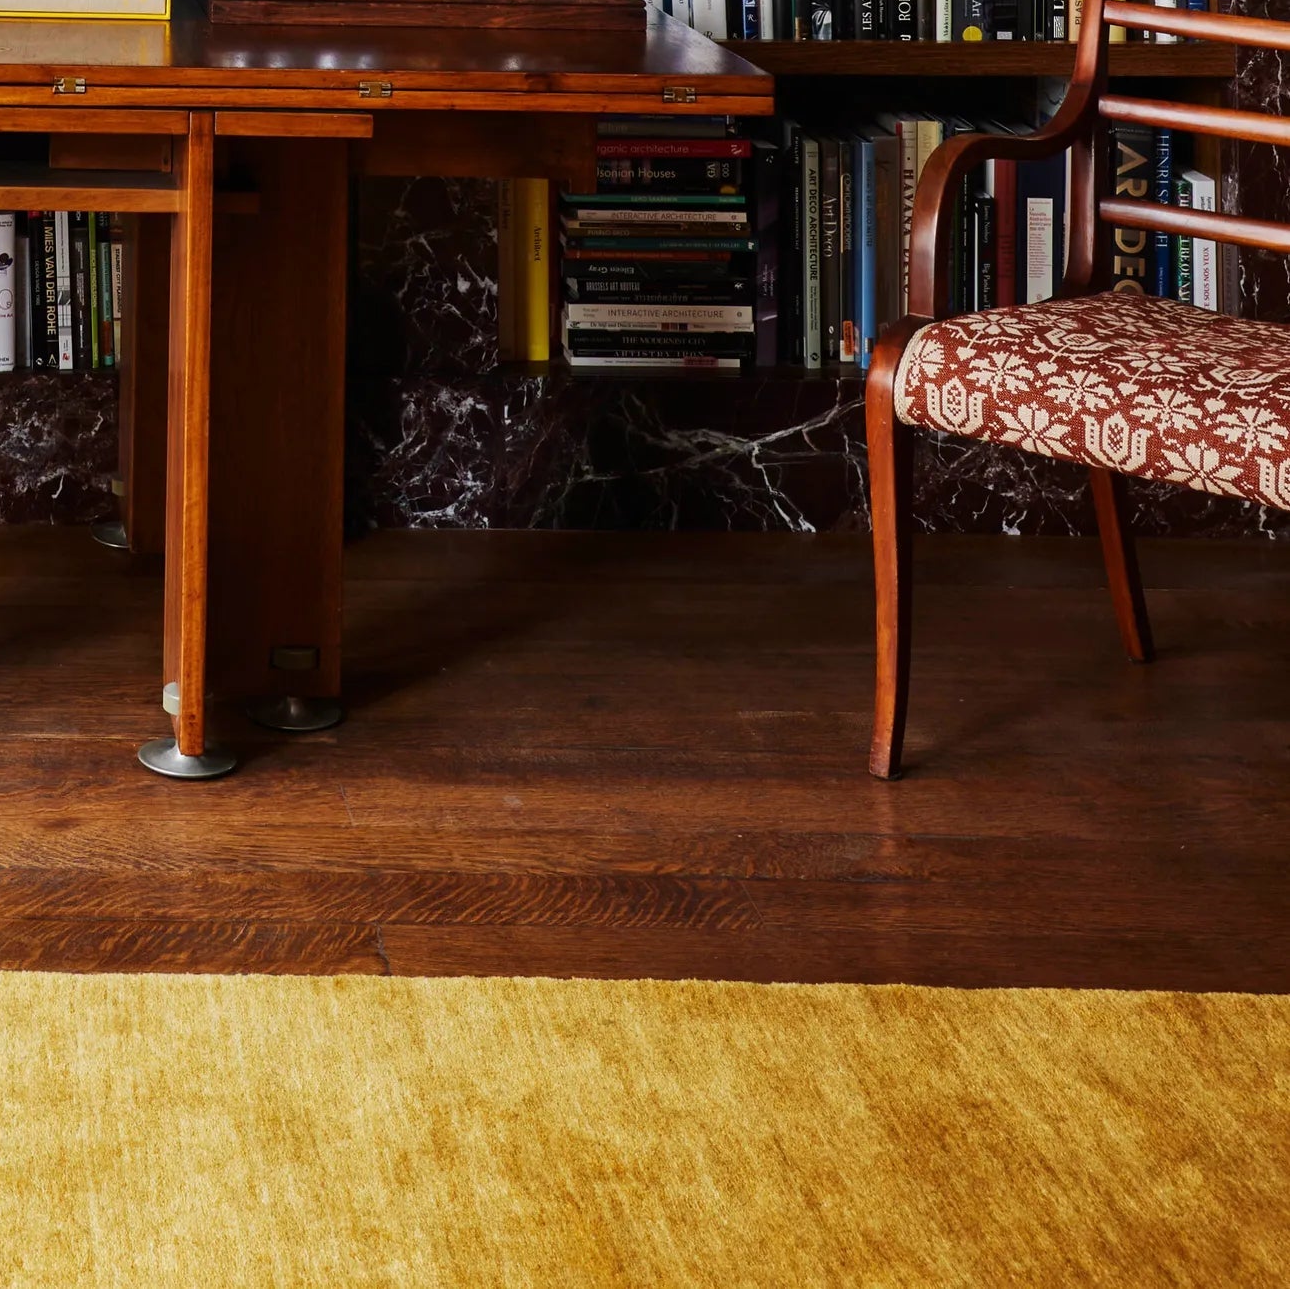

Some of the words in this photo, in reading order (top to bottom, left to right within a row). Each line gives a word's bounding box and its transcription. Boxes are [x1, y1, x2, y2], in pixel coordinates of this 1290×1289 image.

[809, 189, 817, 214] DECO
[44, 227, 55, 253] MIES
[809, 216, 818, 281] ARCHITECTURE
[45, 256, 56, 279] VAN
[46, 282, 56, 303] DER
[46, 306, 56, 335] ROHE
